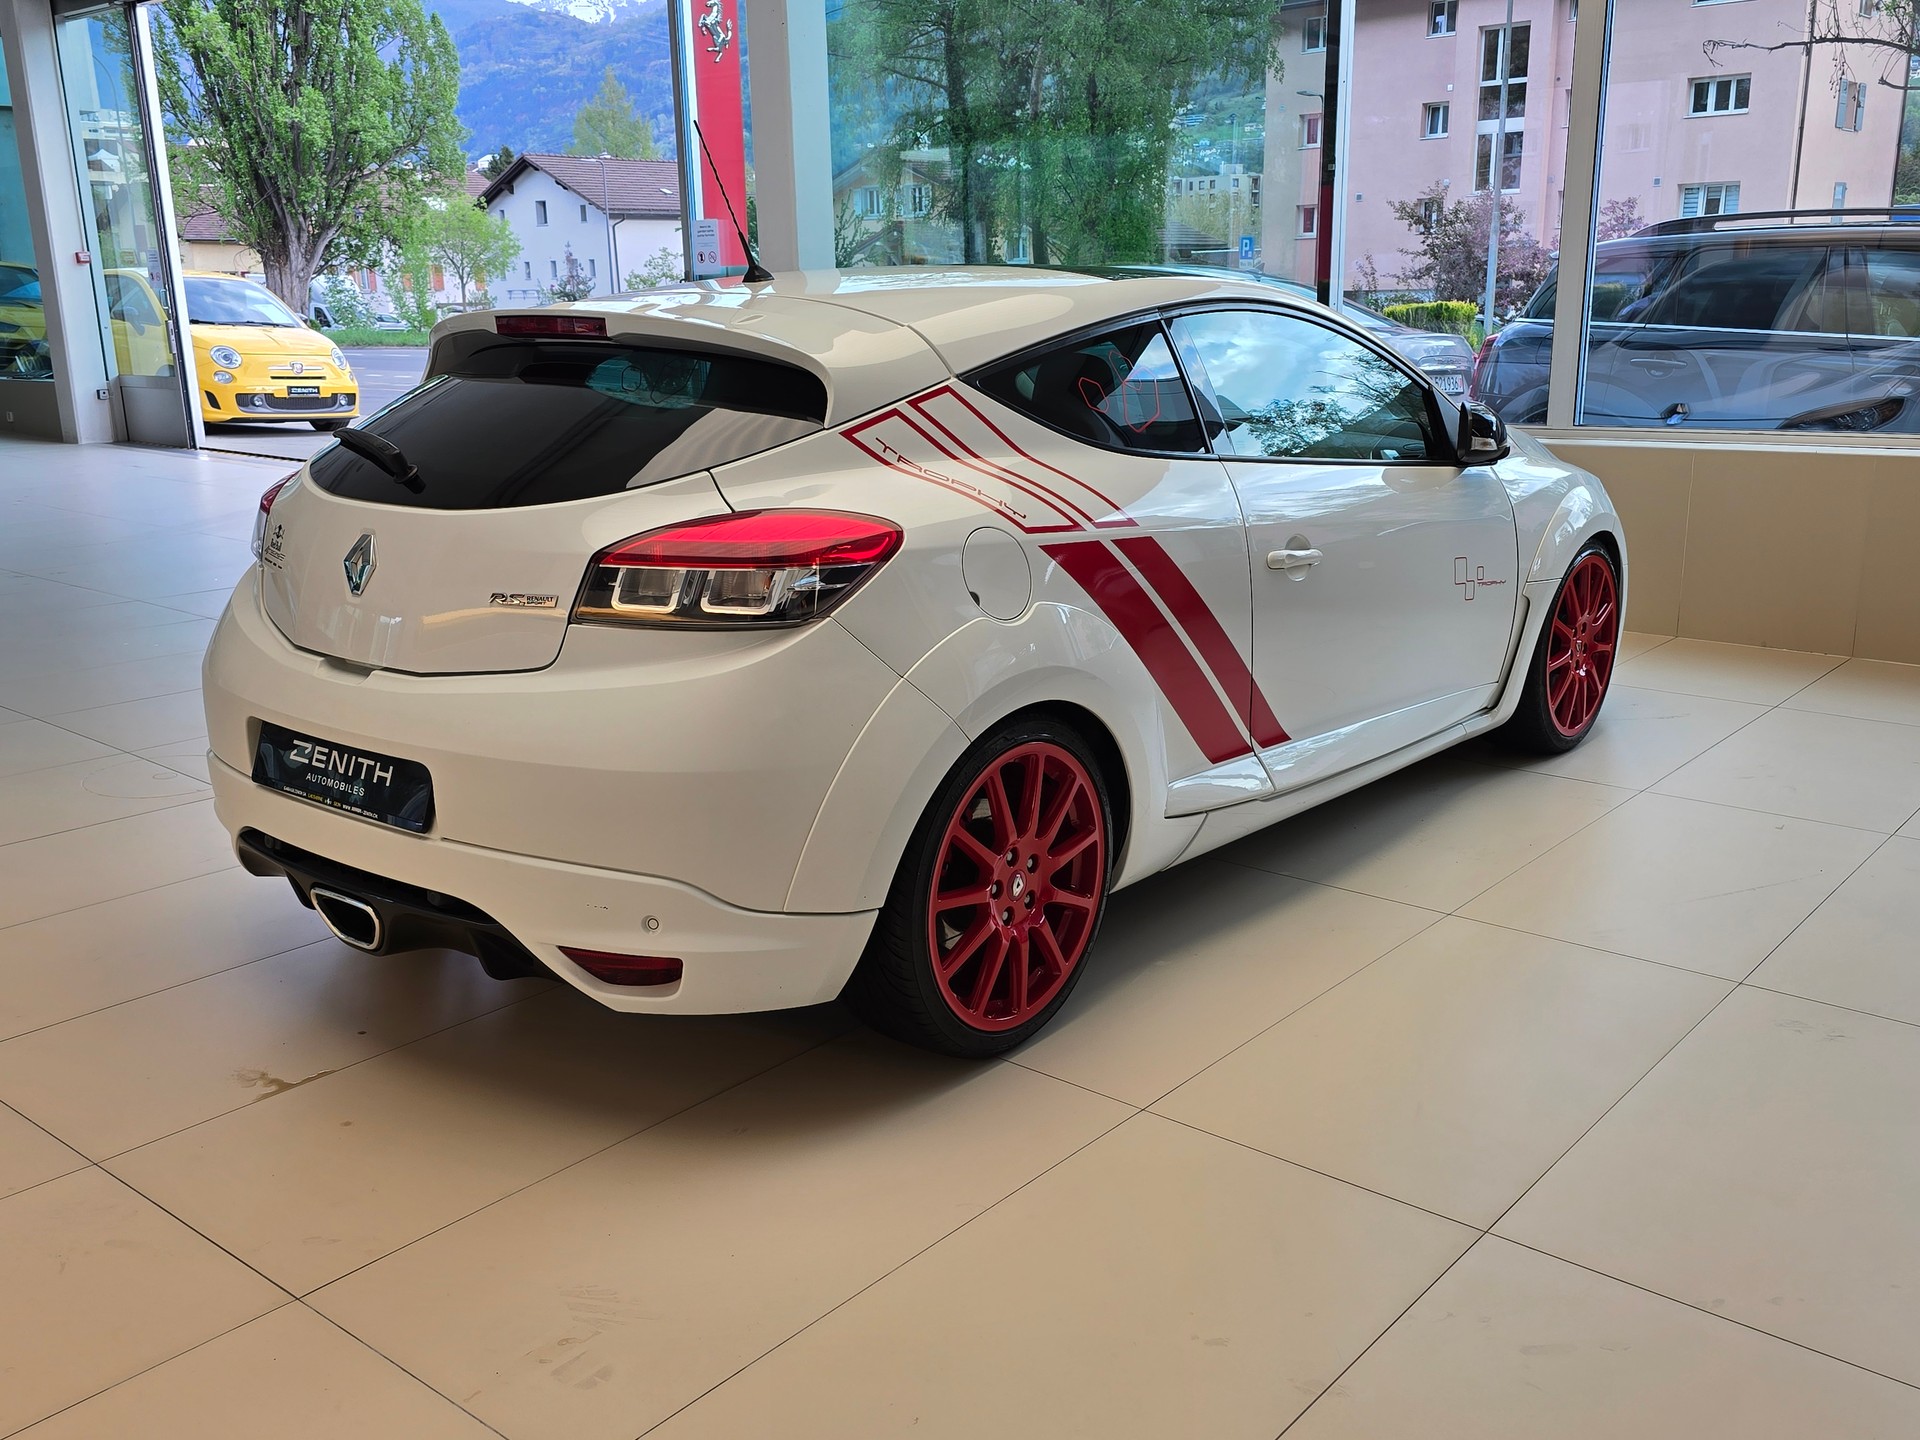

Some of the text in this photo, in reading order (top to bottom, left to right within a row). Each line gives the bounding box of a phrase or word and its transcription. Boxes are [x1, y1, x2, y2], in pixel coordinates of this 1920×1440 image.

[875, 437, 1027, 519] TROPHY
[289, 739, 394, 787] ZENITH
[305, 772, 366, 797] AUTOMOBILES
